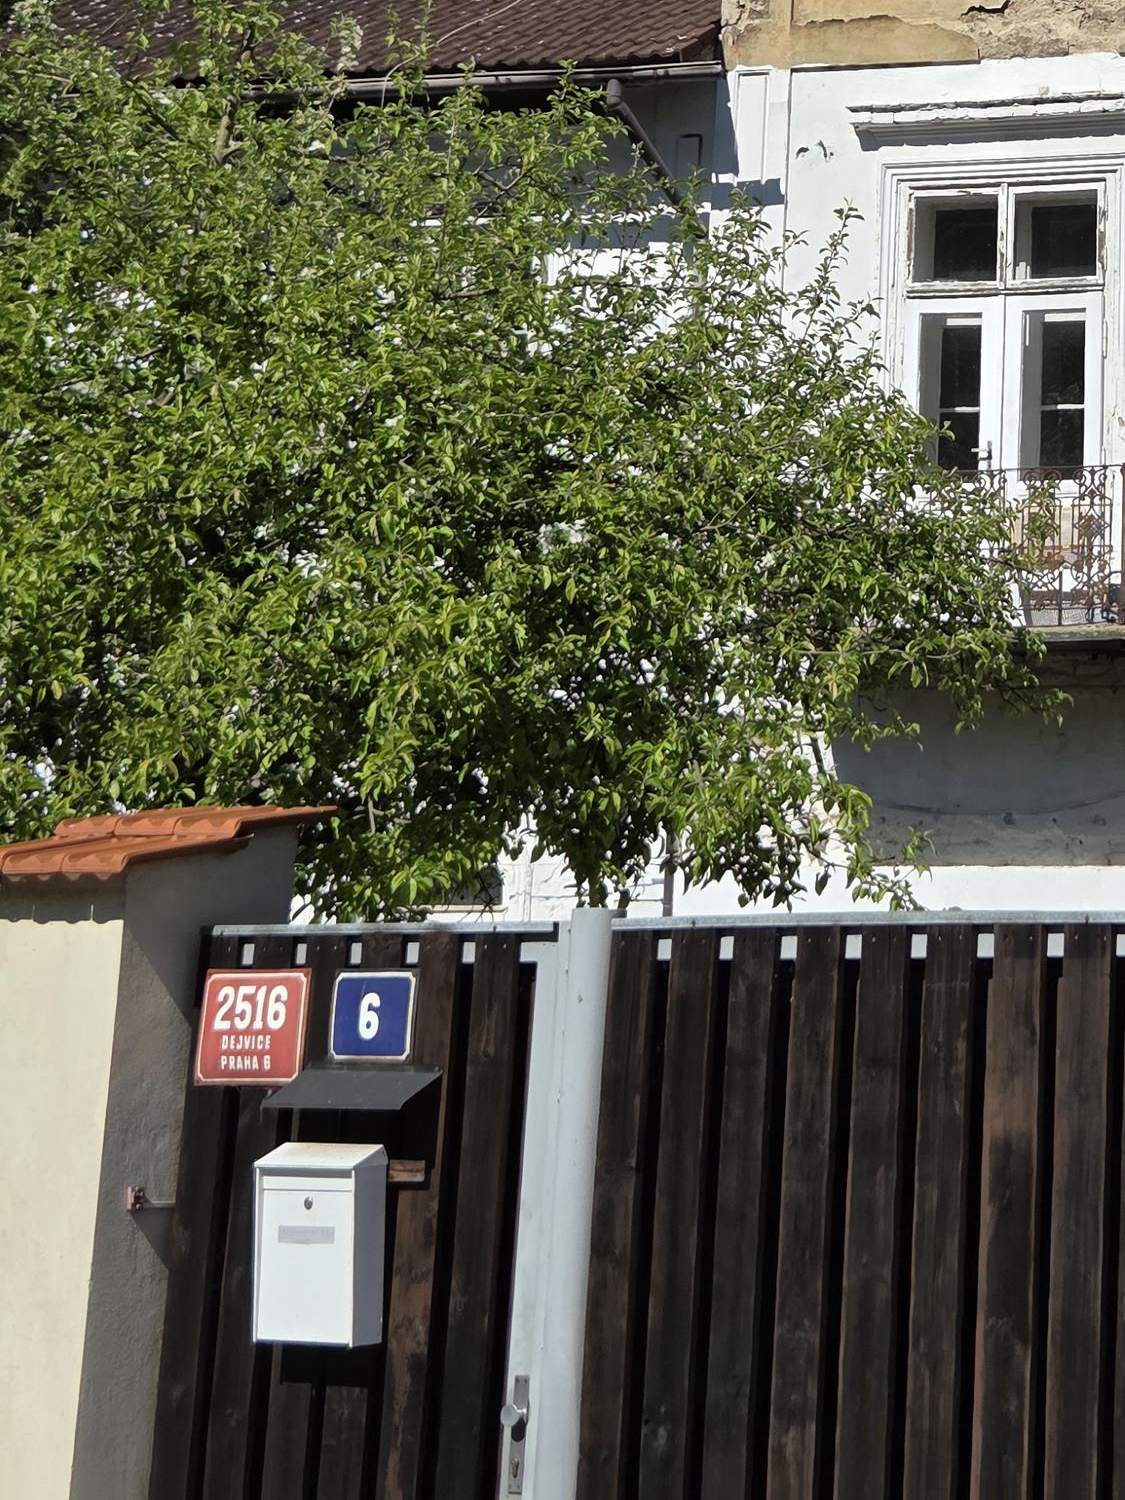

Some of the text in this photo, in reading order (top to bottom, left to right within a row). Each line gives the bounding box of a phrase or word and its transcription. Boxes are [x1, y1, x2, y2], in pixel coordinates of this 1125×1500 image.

[213, 985, 288, 1030] 2516
[359, 992, 381, 1040] 6
[221, 1034, 271, 1050] DEJVICE
[220, 1055, 271, 1070] PRAHA 6
